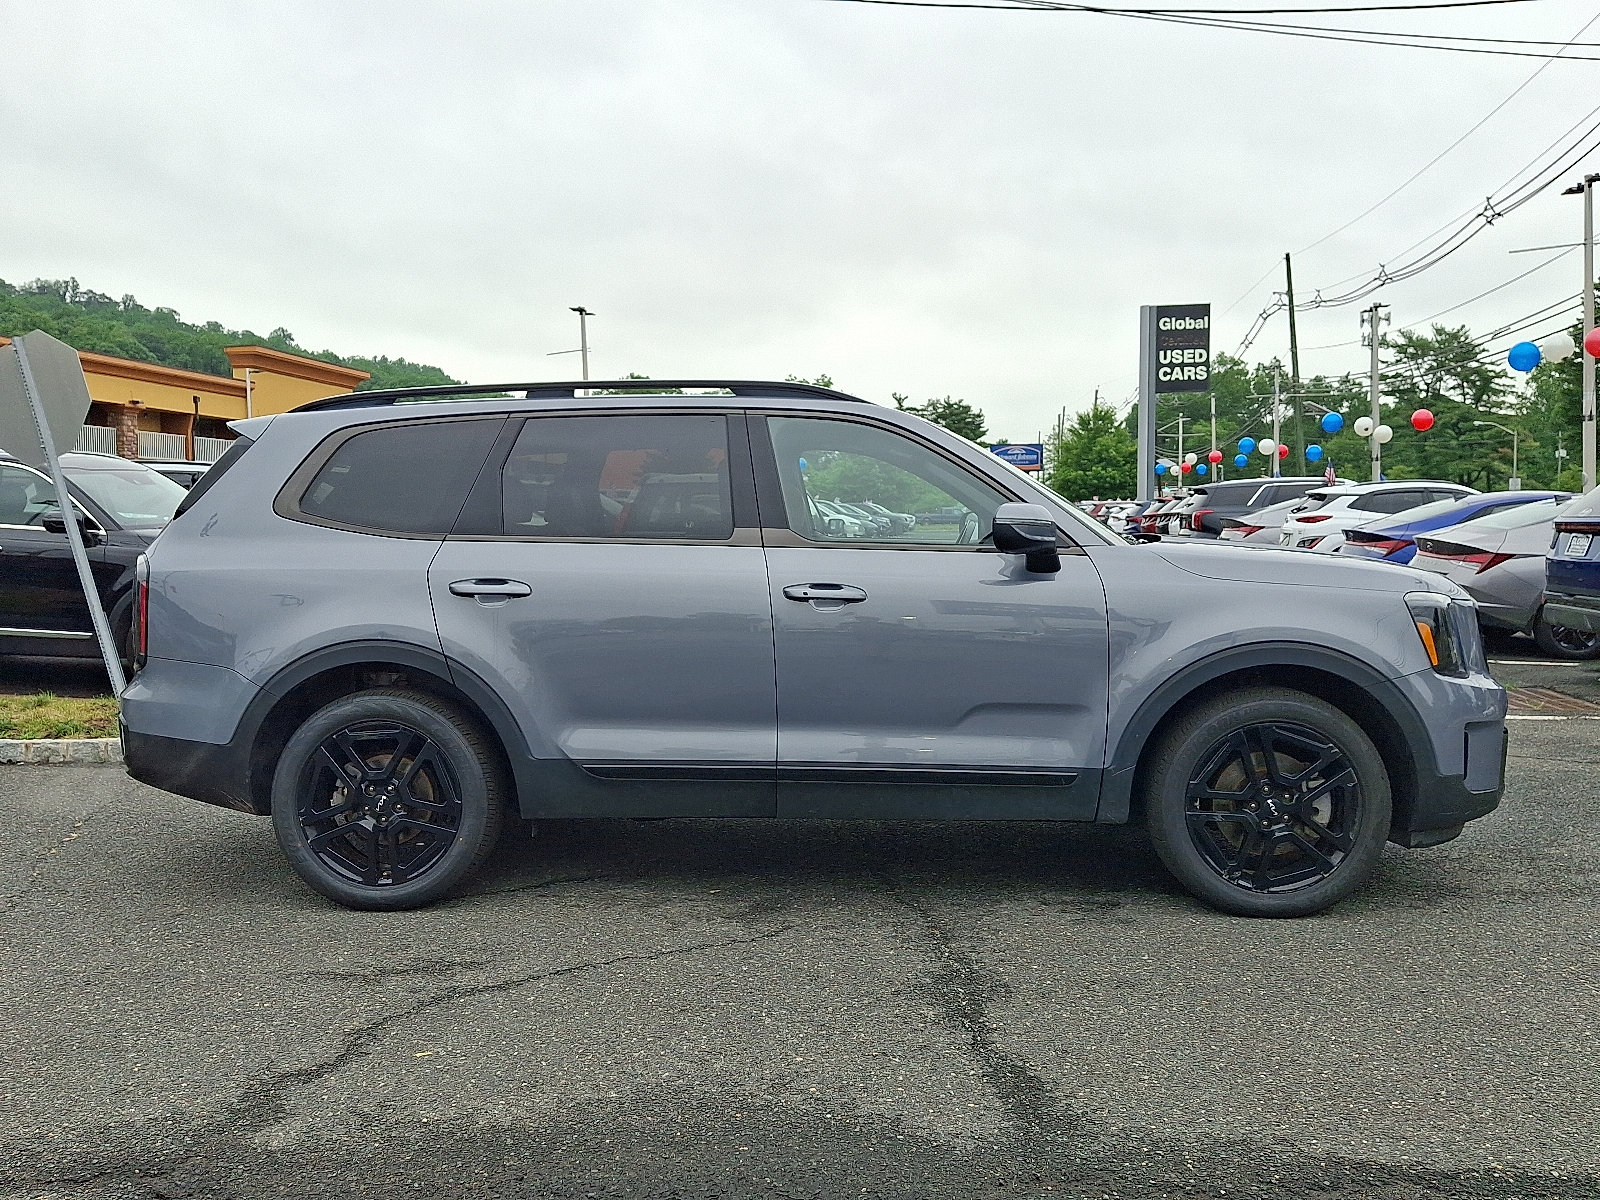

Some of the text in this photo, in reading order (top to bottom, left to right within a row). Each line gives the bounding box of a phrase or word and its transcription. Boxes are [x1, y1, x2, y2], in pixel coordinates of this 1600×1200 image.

[1158, 315, 1209, 331] Global
[1158, 348, 1208, 365] USED
[1158, 365, 1208, 381] CARS
